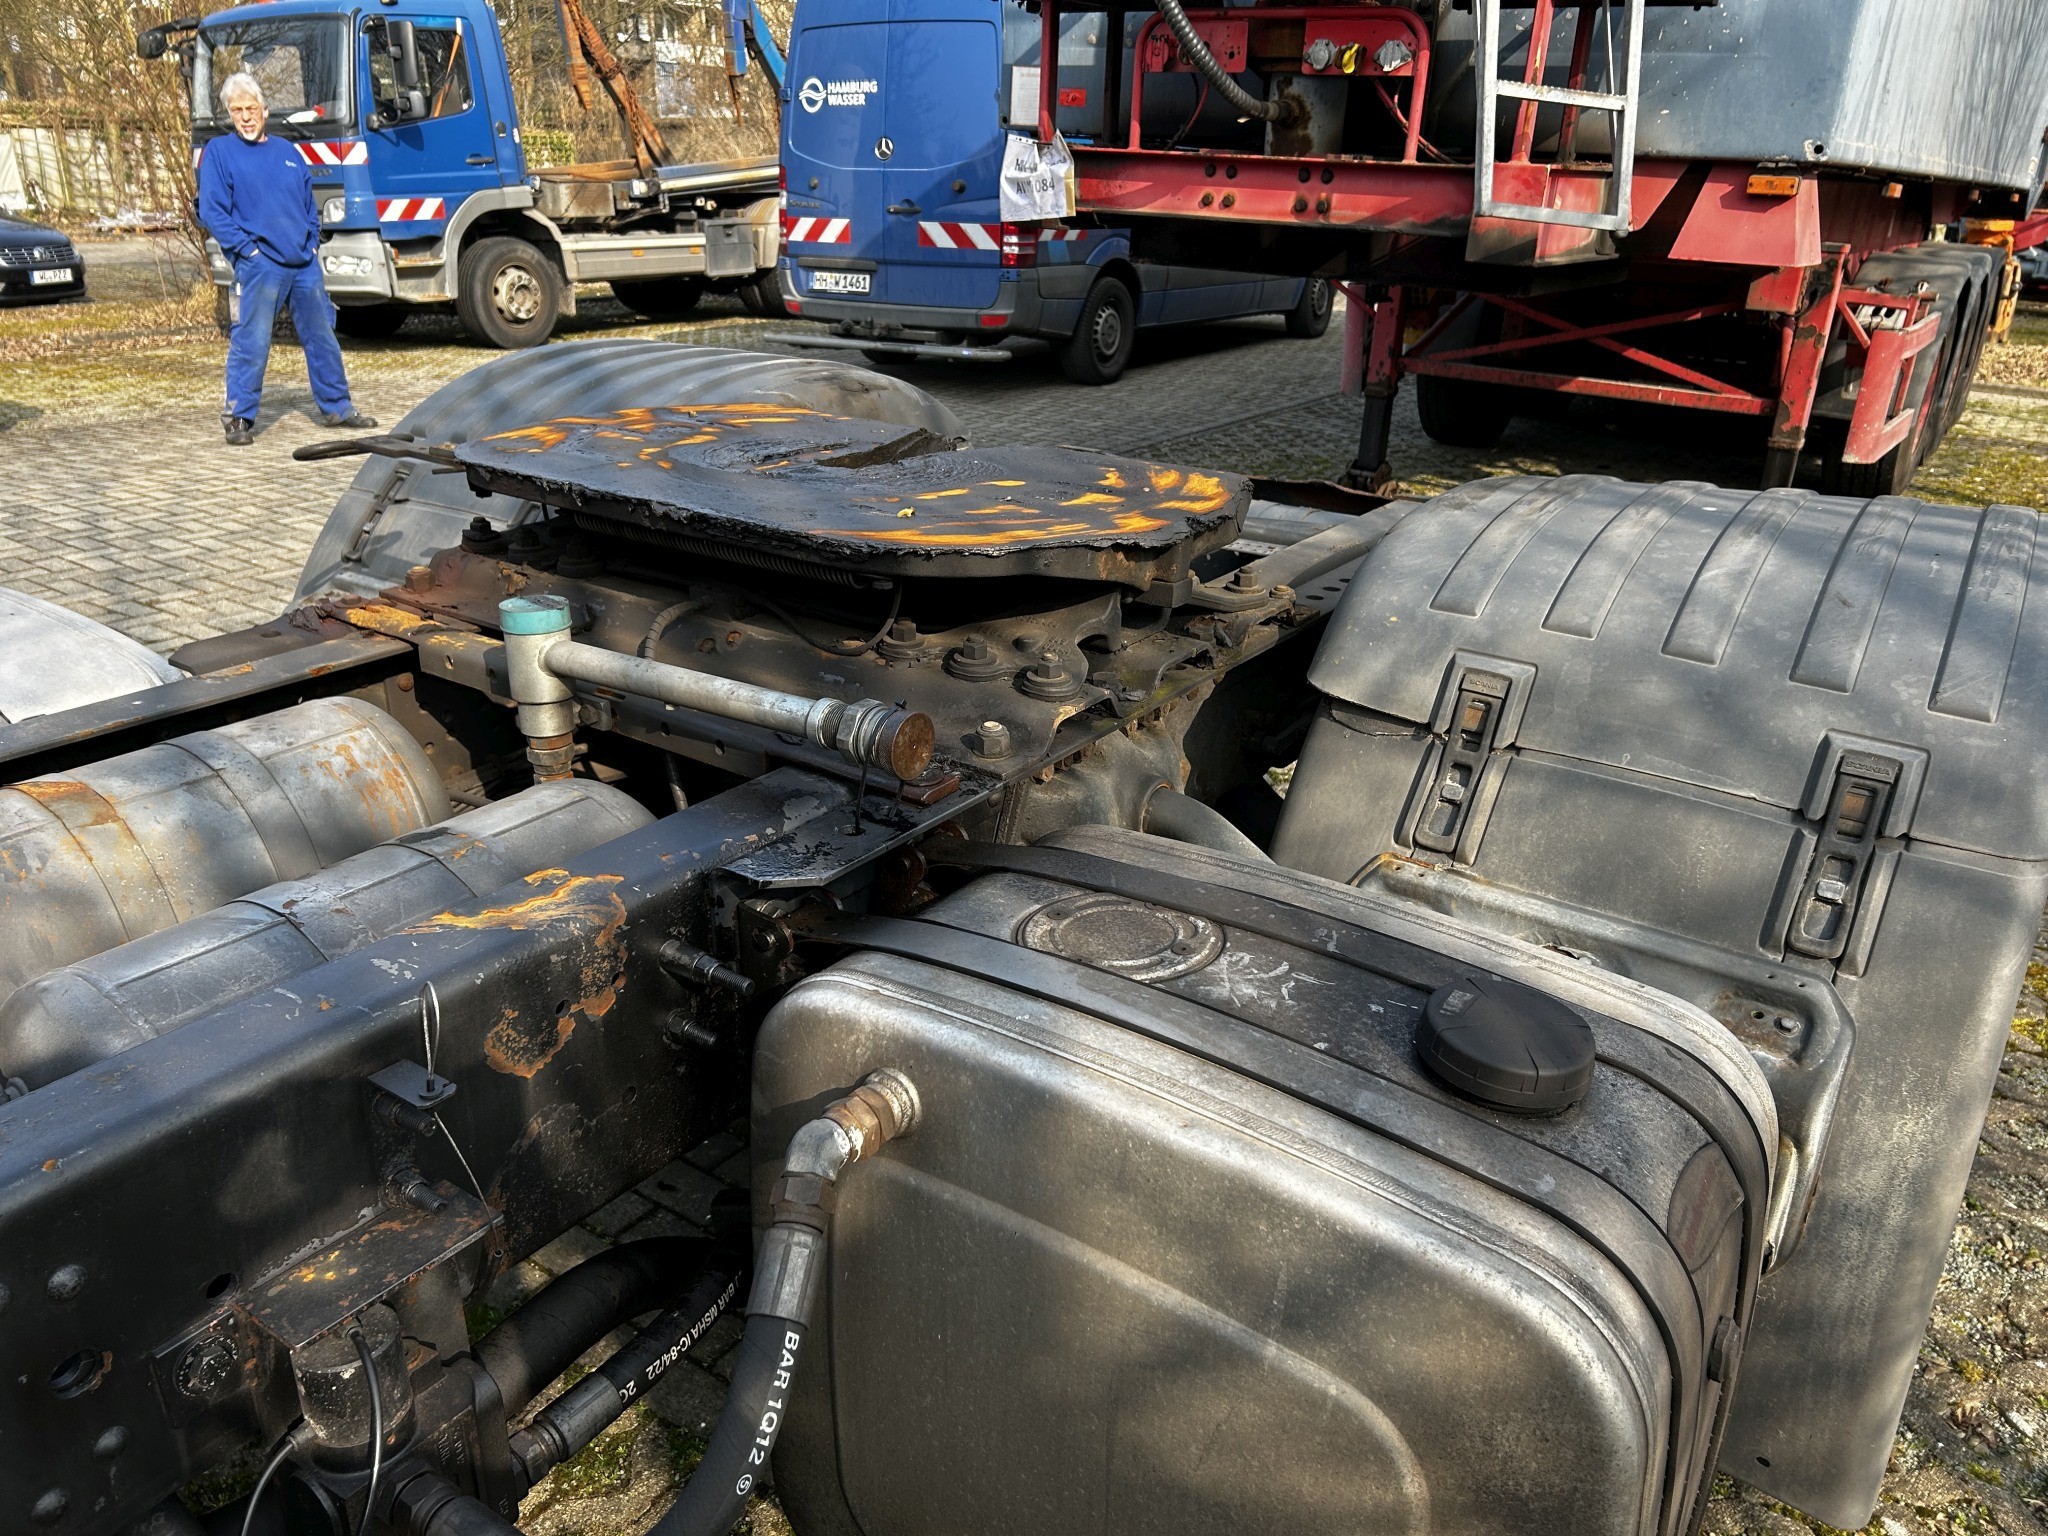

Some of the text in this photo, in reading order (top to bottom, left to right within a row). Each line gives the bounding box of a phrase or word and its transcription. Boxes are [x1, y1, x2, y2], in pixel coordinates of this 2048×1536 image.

[827, 81, 878, 94] HAMBURG
[827, 93, 866, 106] WASSER
[815, 274, 867, 290] HH W1461
[1469, 679, 1499, 691] SCANIA
[1845, 761, 1891, 776] SCANIA
[718, 1282, 735, 1311] BAR
[691, 1304, 718, 1339] MSHA
[645, 1333, 691, 1380] IC-84/22
[773, 1330, 800, 1389] BAR
[748, 1398, 782, 1465] 1Q12
